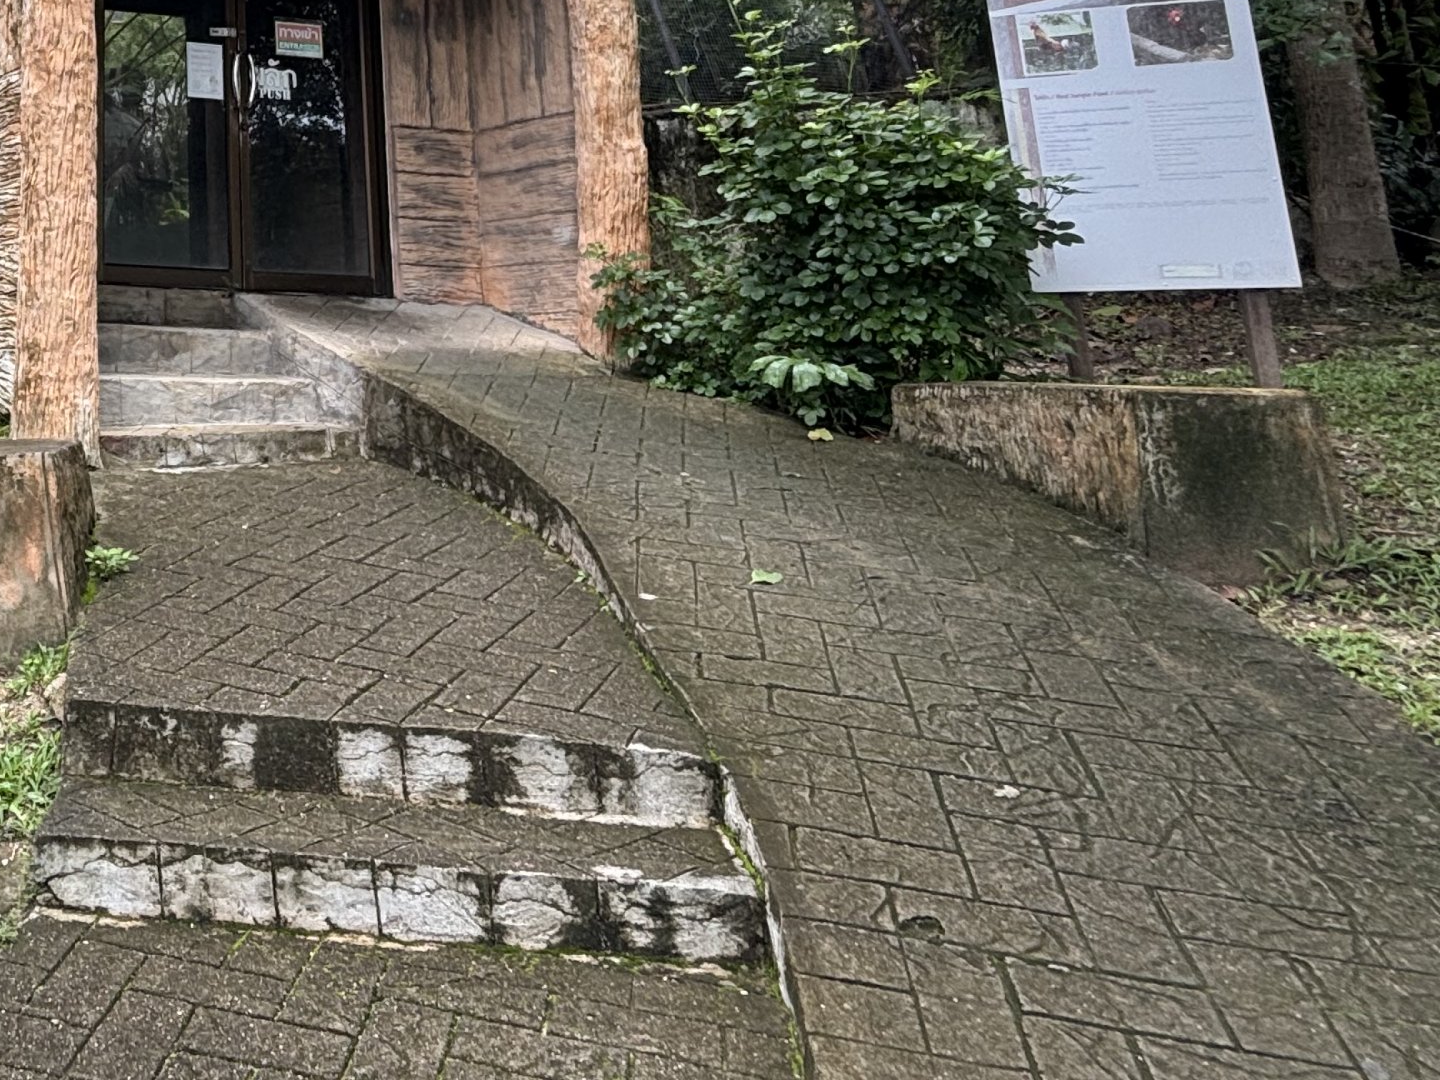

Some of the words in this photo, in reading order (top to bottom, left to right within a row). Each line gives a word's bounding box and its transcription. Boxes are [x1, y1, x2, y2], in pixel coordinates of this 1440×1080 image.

[279, 27, 319, 40] ทางเข้า
[259, 87, 291, 100] PUSH
